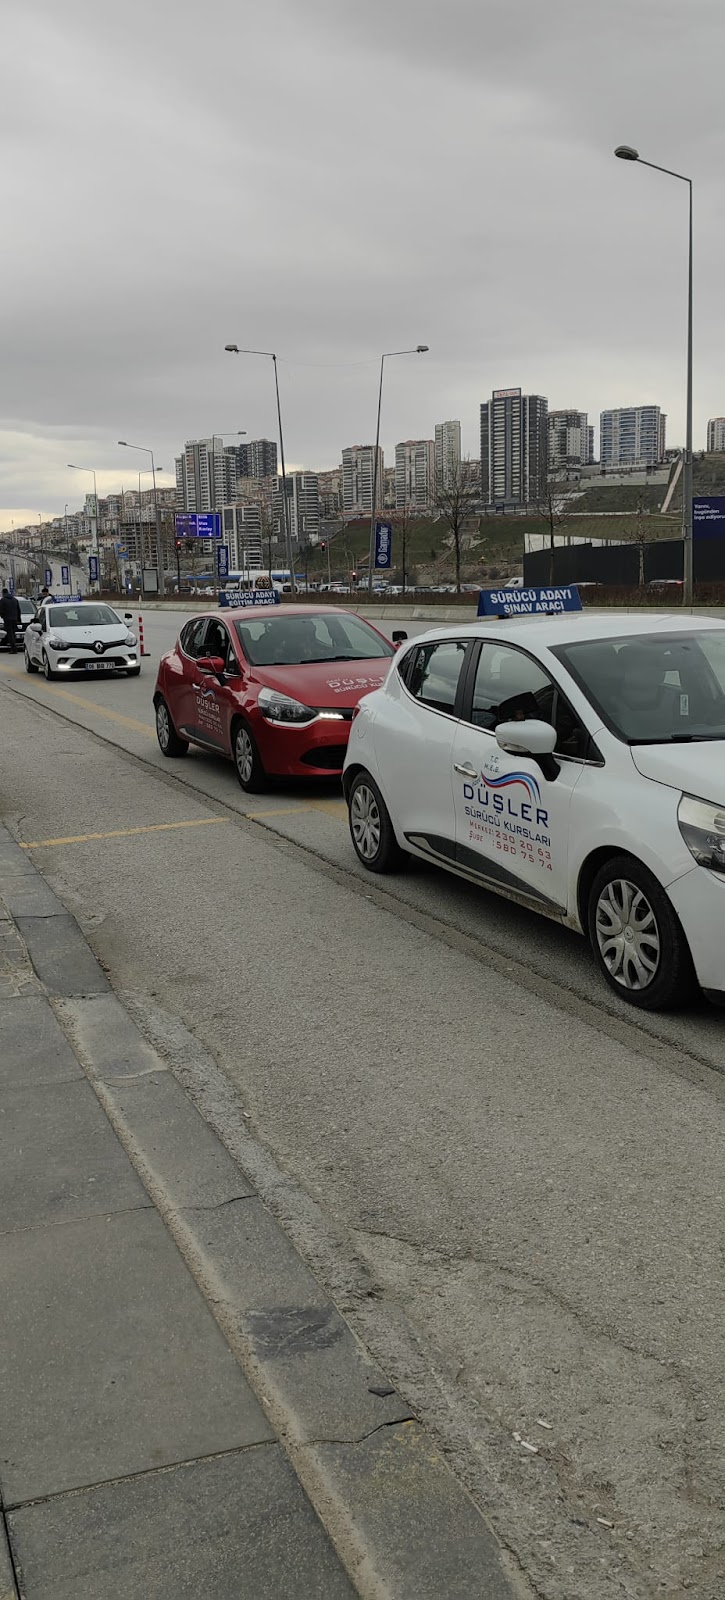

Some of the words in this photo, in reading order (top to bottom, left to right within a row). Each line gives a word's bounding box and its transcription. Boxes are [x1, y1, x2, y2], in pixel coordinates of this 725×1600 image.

[490, 590, 536, 604] SÜRÜCÜ
[540, 589, 572, 600] ADAYI
[504, 603, 533, 613] SINAV
[535, 601, 564, 611] ARACI
[463, 783, 549, 828] DÜŞLER
[464, 805, 501, 827] SÜRÜCÜ
[503, 820, 551, 847] KURSLARI
[495, 830, 516, 844] 230
[519, 840, 533, 851] 20
[537, 847, 551, 860] 63
[520, 851, 534, 863] 75
[538, 859, 553, 871] 74
